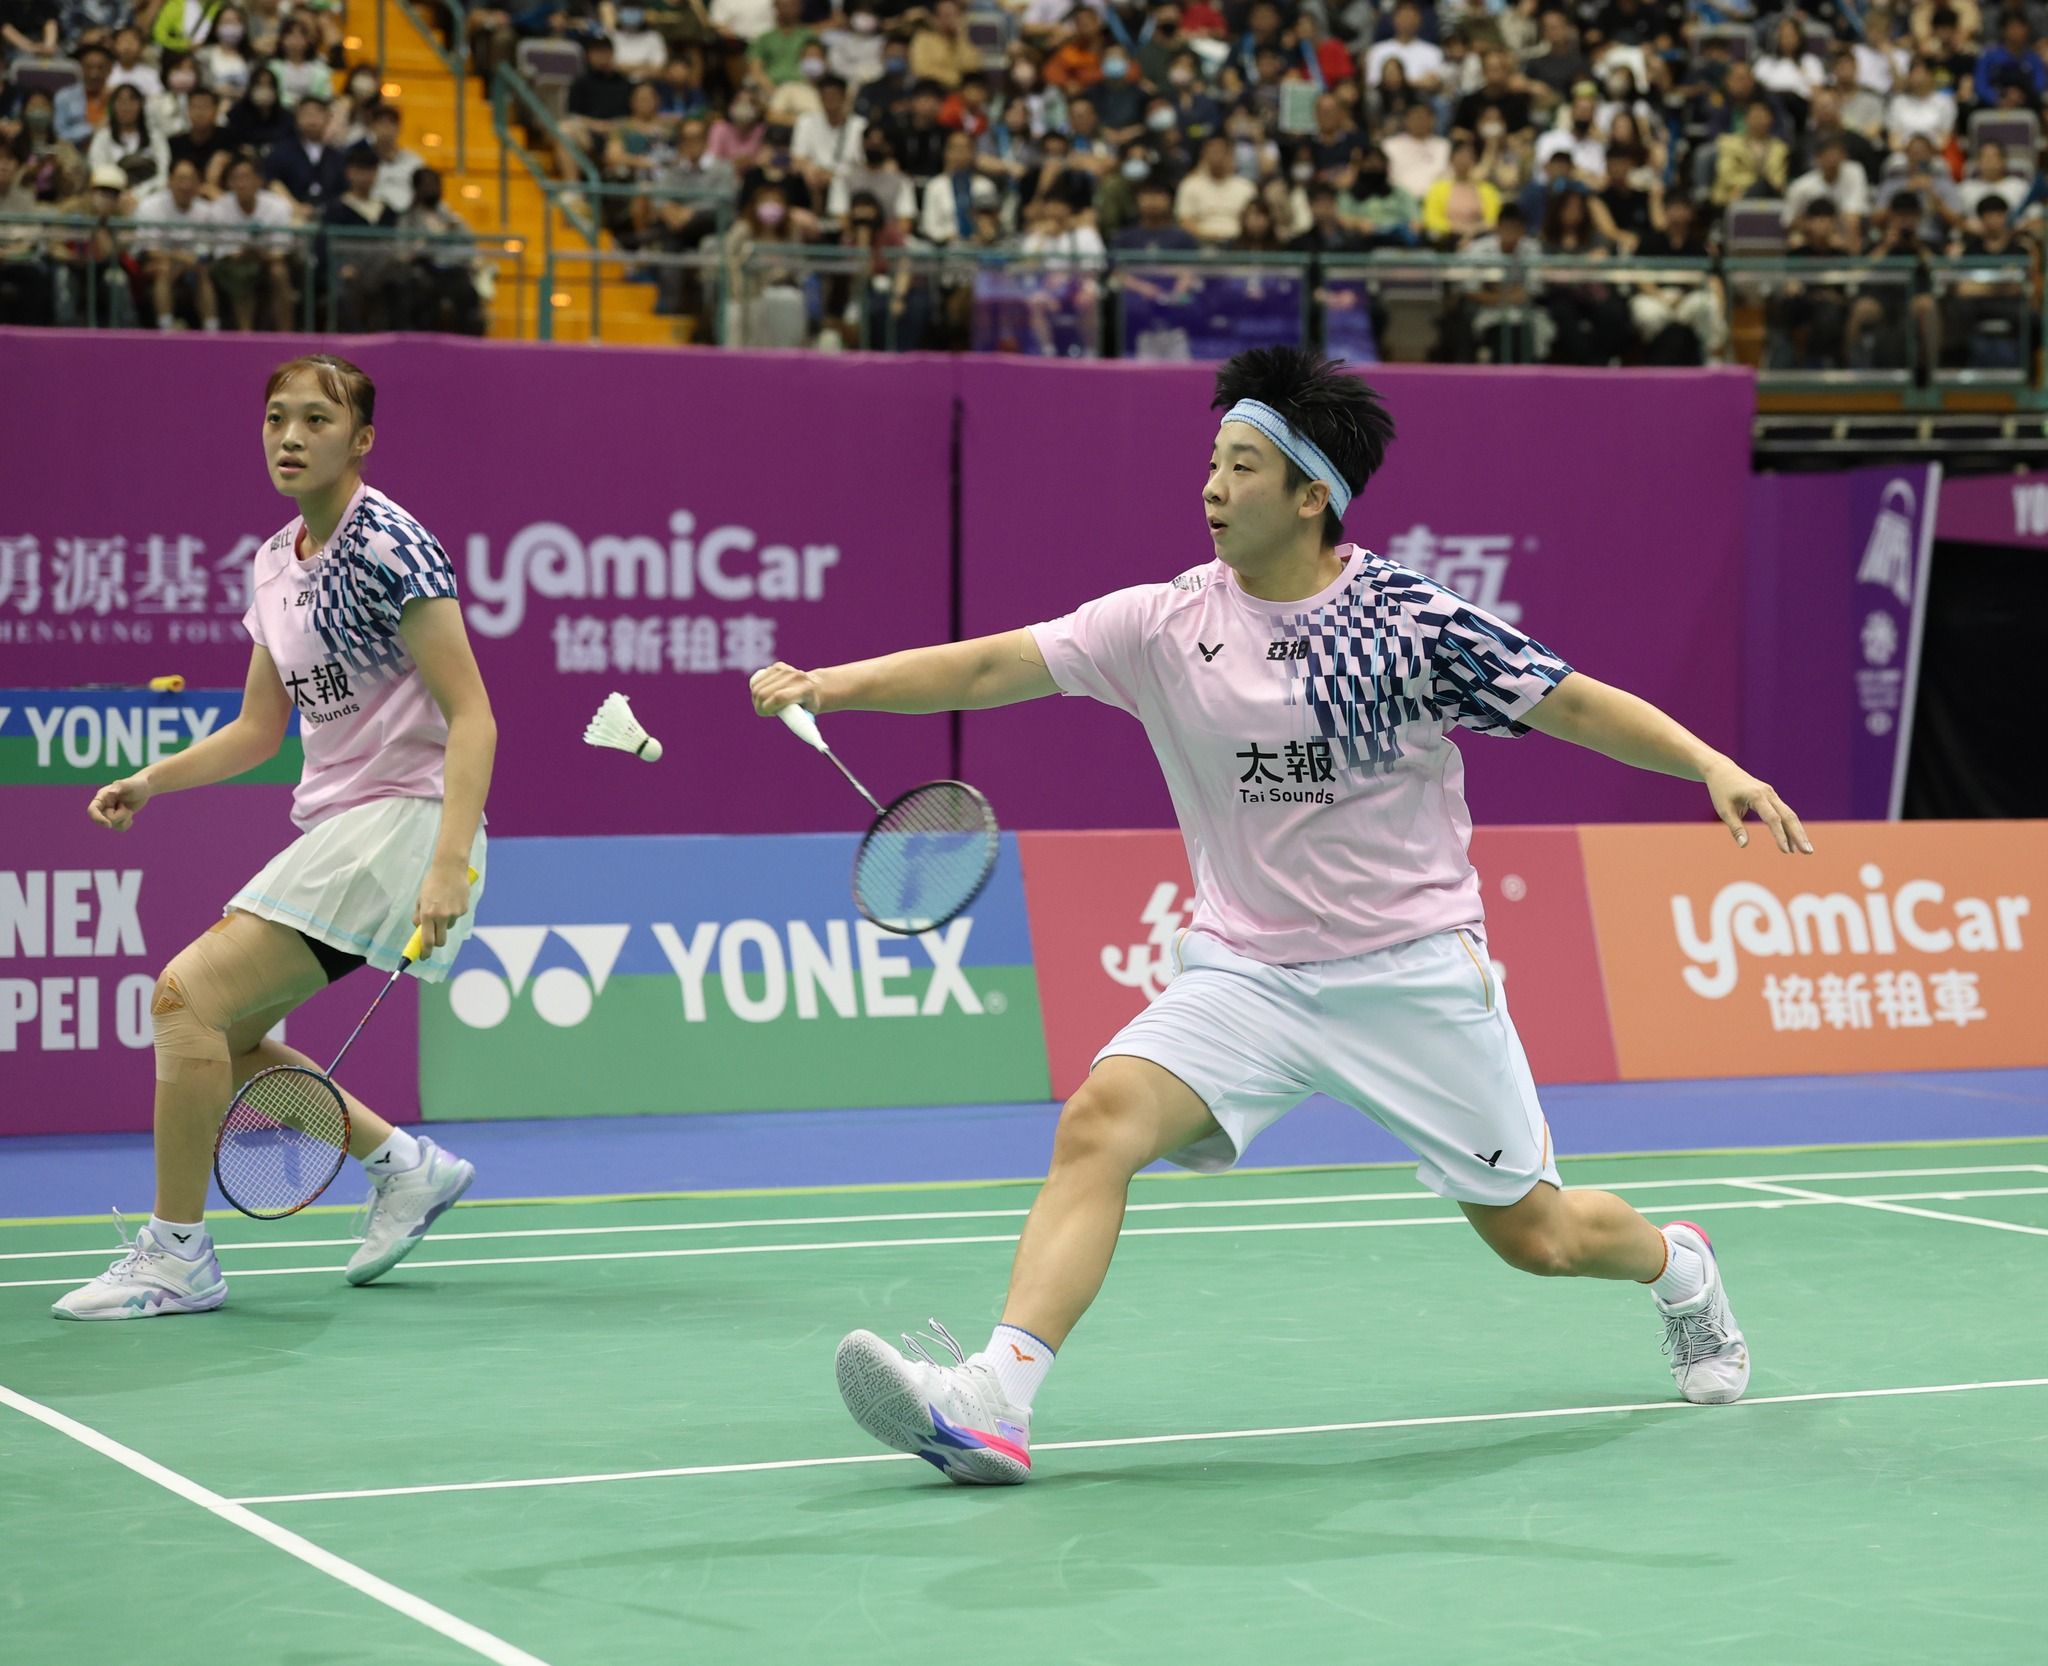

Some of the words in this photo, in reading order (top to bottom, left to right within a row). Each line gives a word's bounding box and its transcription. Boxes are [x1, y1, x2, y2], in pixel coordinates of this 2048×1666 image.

[285, 662, 355, 708] 太報
[1236, 740, 1337, 785] 太報
[1239, 788, 1266, 803] Tai
[1269, 788, 1335, 805] Sounds
[650, 917, 985, 1023] YONEX
[1763, 969, 1988, 1033] 協新租車
